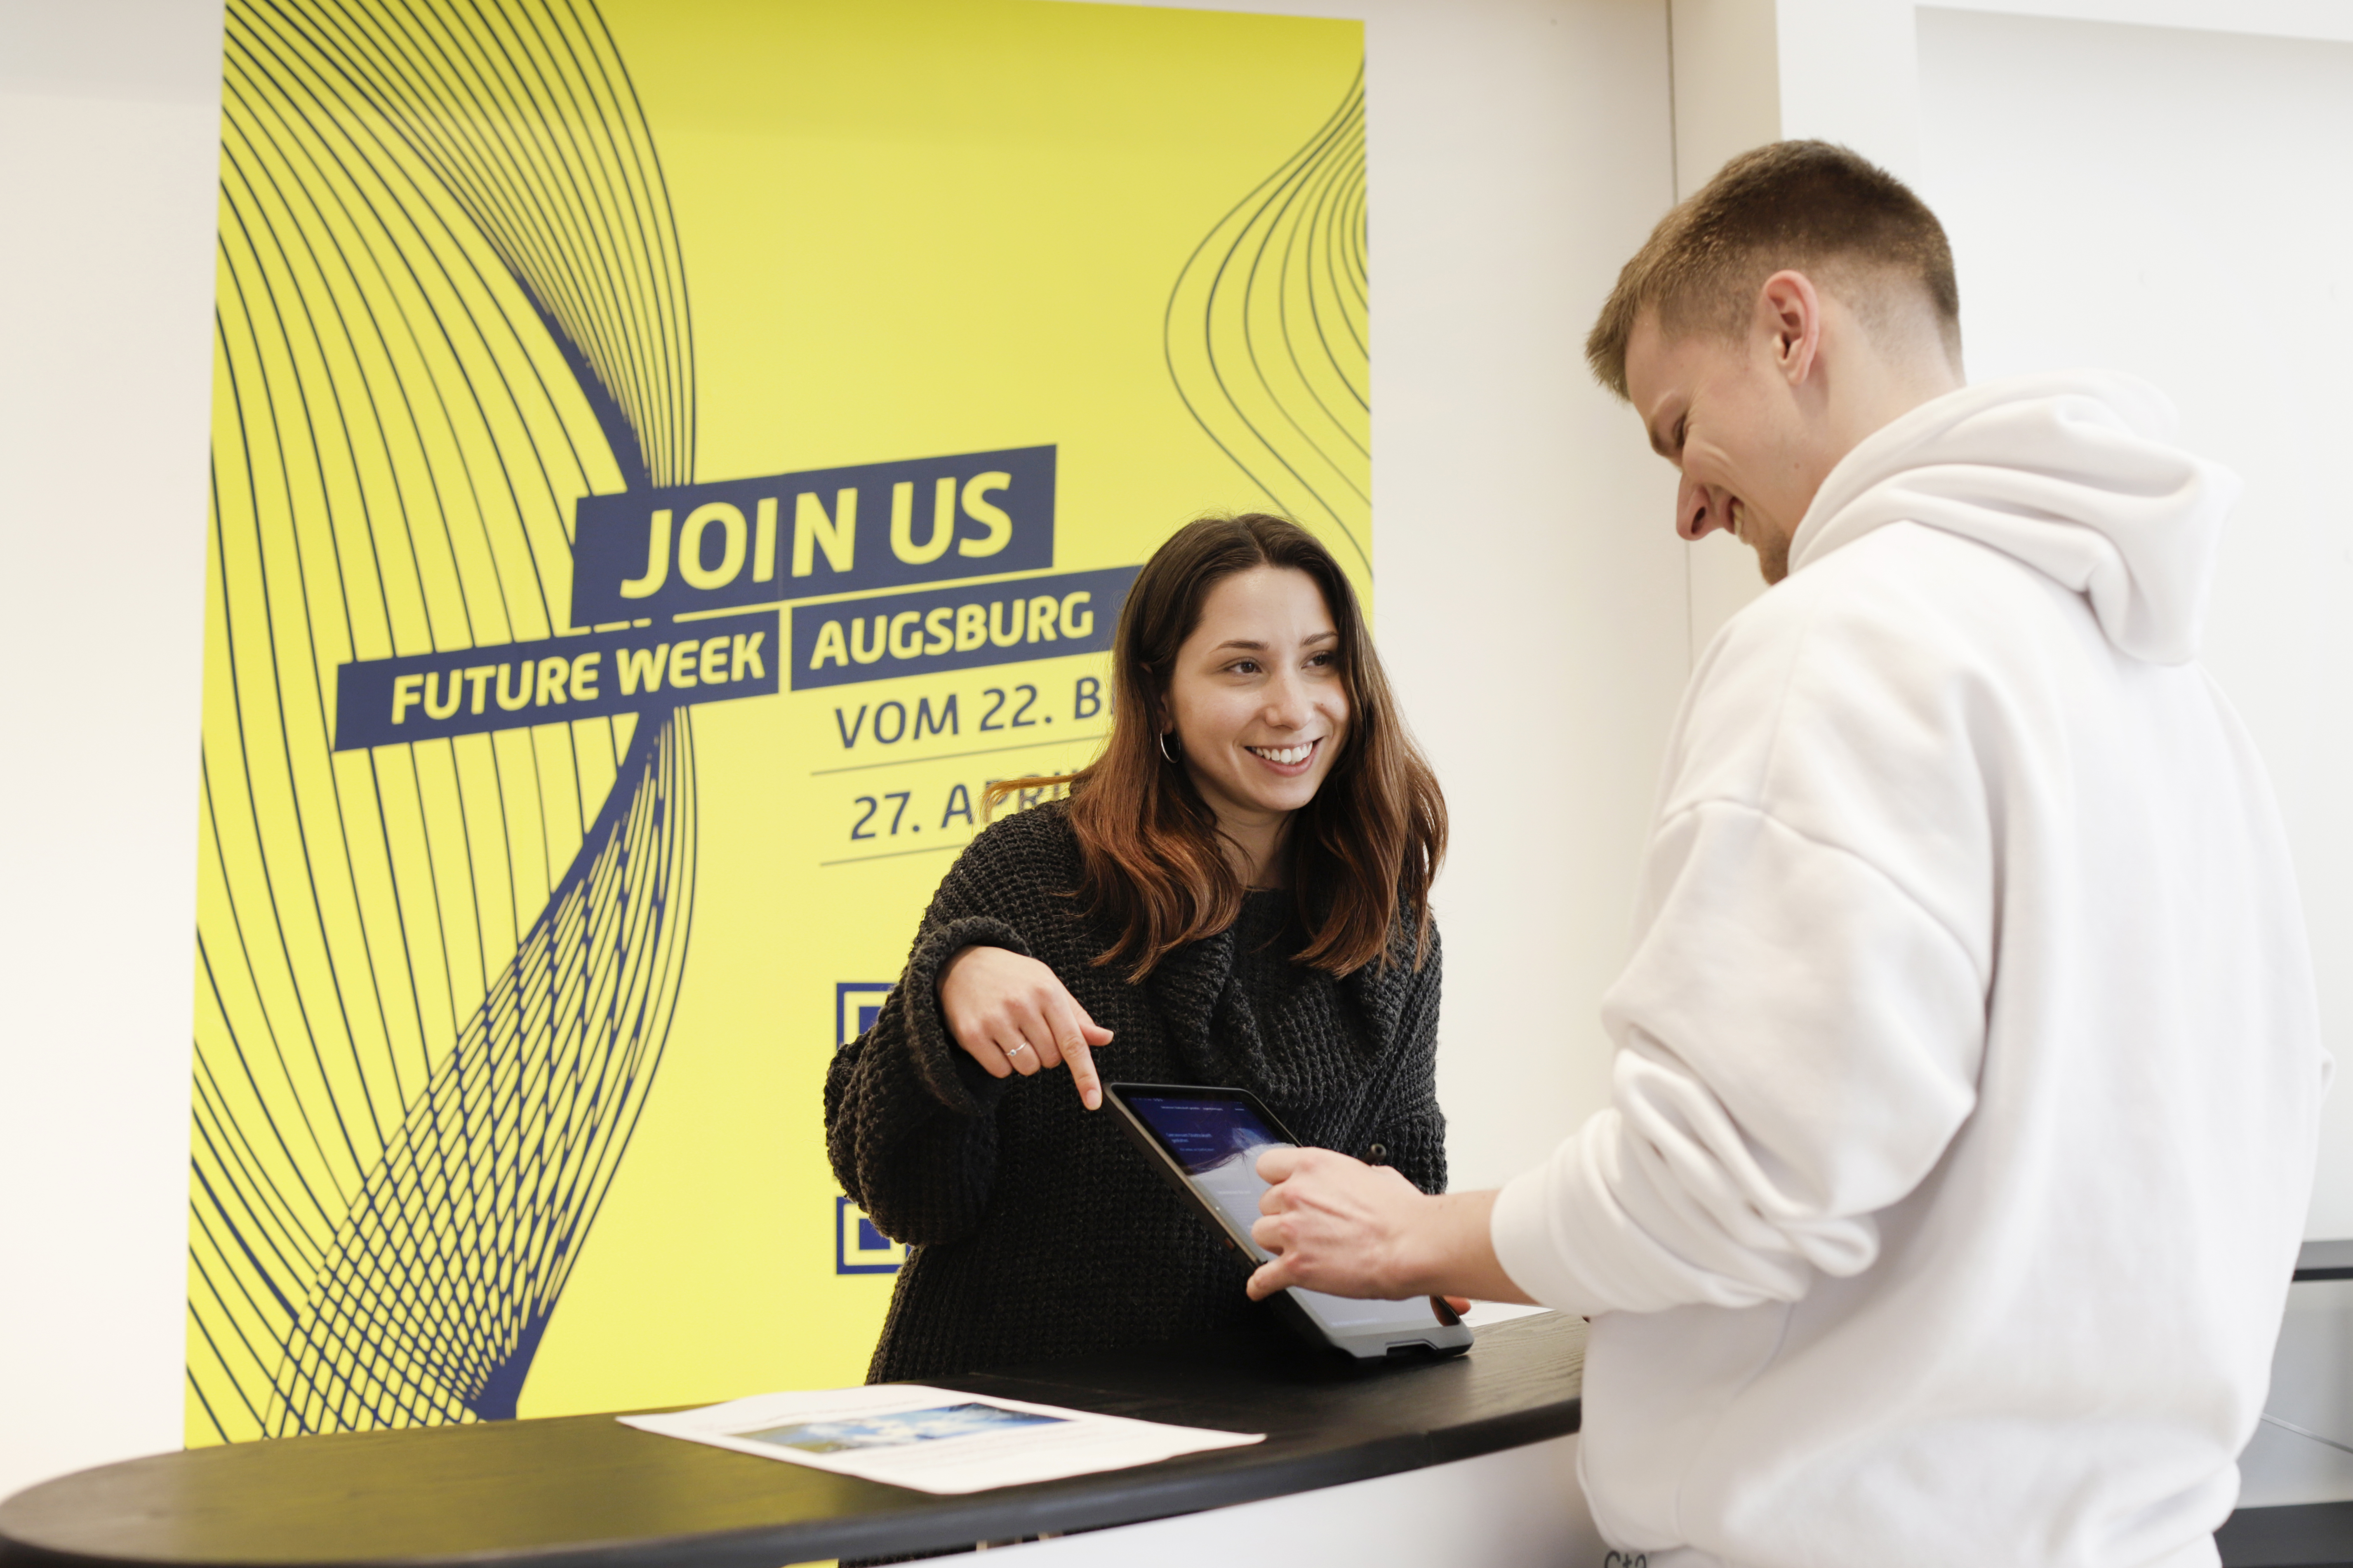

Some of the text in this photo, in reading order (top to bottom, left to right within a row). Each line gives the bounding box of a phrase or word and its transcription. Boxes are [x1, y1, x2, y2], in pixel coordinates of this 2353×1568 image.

[619, 471, 1013, 599] JOIN US
[809, 590, 1094, 670] AUGSBURG
[391, 631, 766, 725] FUTURE WEEK
[835, 694, 959, 749] VOM
[980, 684, 1052, 732] 22.
[851, 791, 920, 841] 27.
